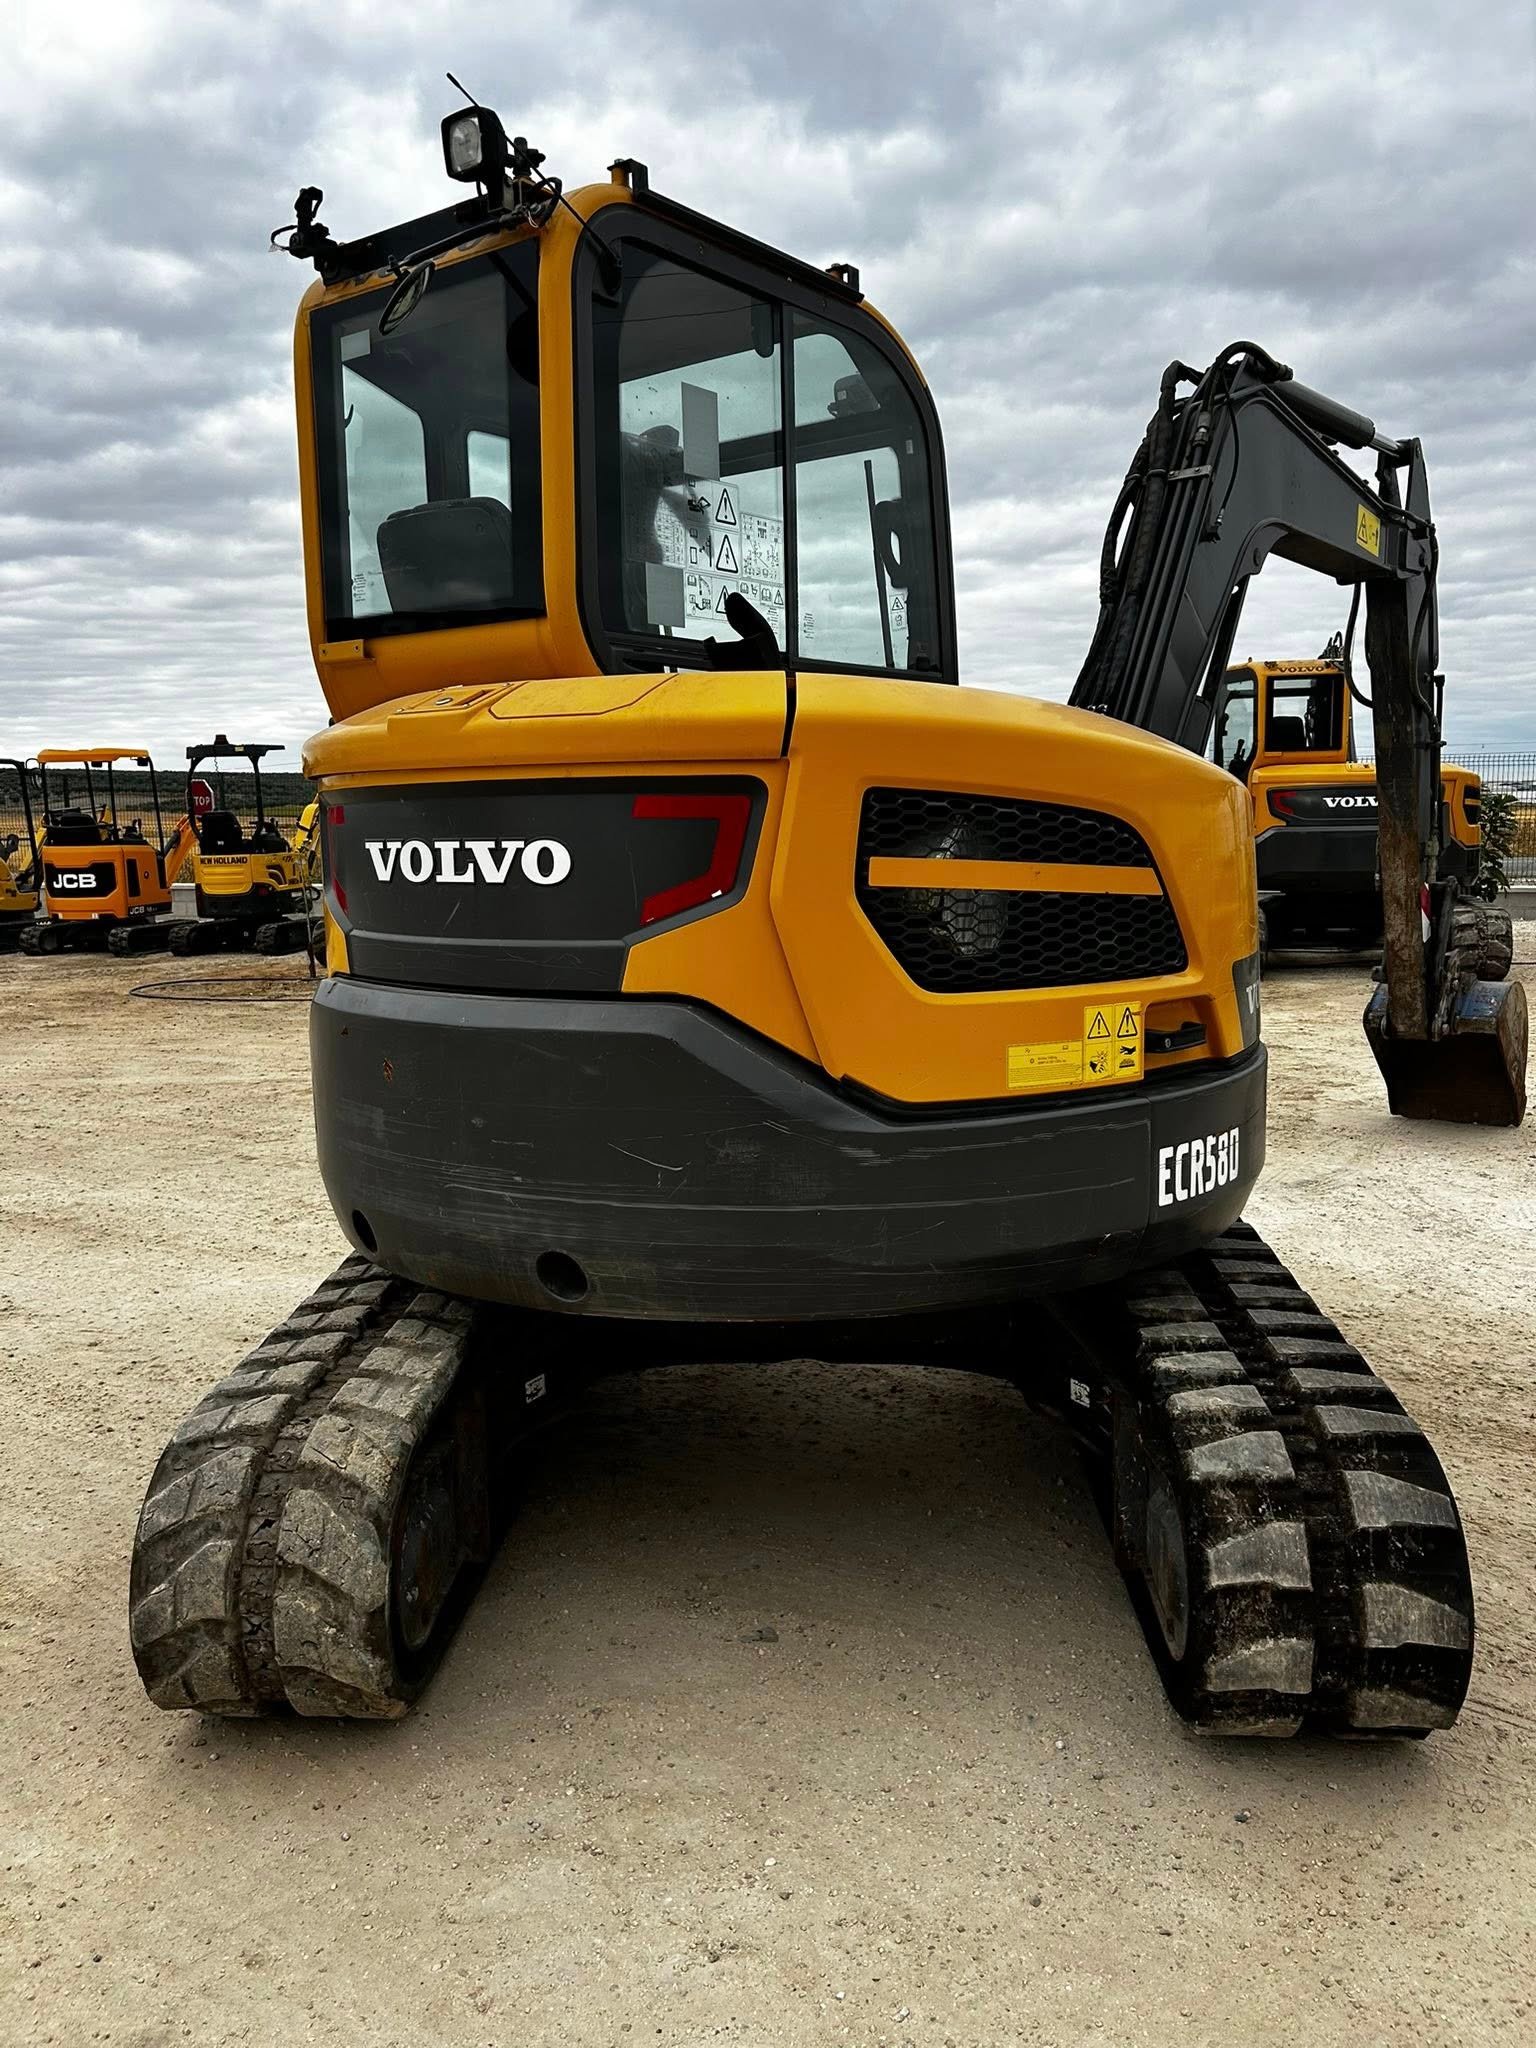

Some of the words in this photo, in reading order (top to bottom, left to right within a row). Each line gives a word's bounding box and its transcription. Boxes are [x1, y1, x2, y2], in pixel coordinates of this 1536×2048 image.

[192, 796, 211, 806] TOP
[1322, 796, 1379, 808] VOLV
[200, 857, 212, 865] NEW
[213, 856, 248, 865] HOLLAND
[364, 839, 572, 885] VOLVO
[53, 873, 97, 889] JCB
[129, 906, 145, 915] JCB
[1158, 1126, 1240, 1207] ECR58D
